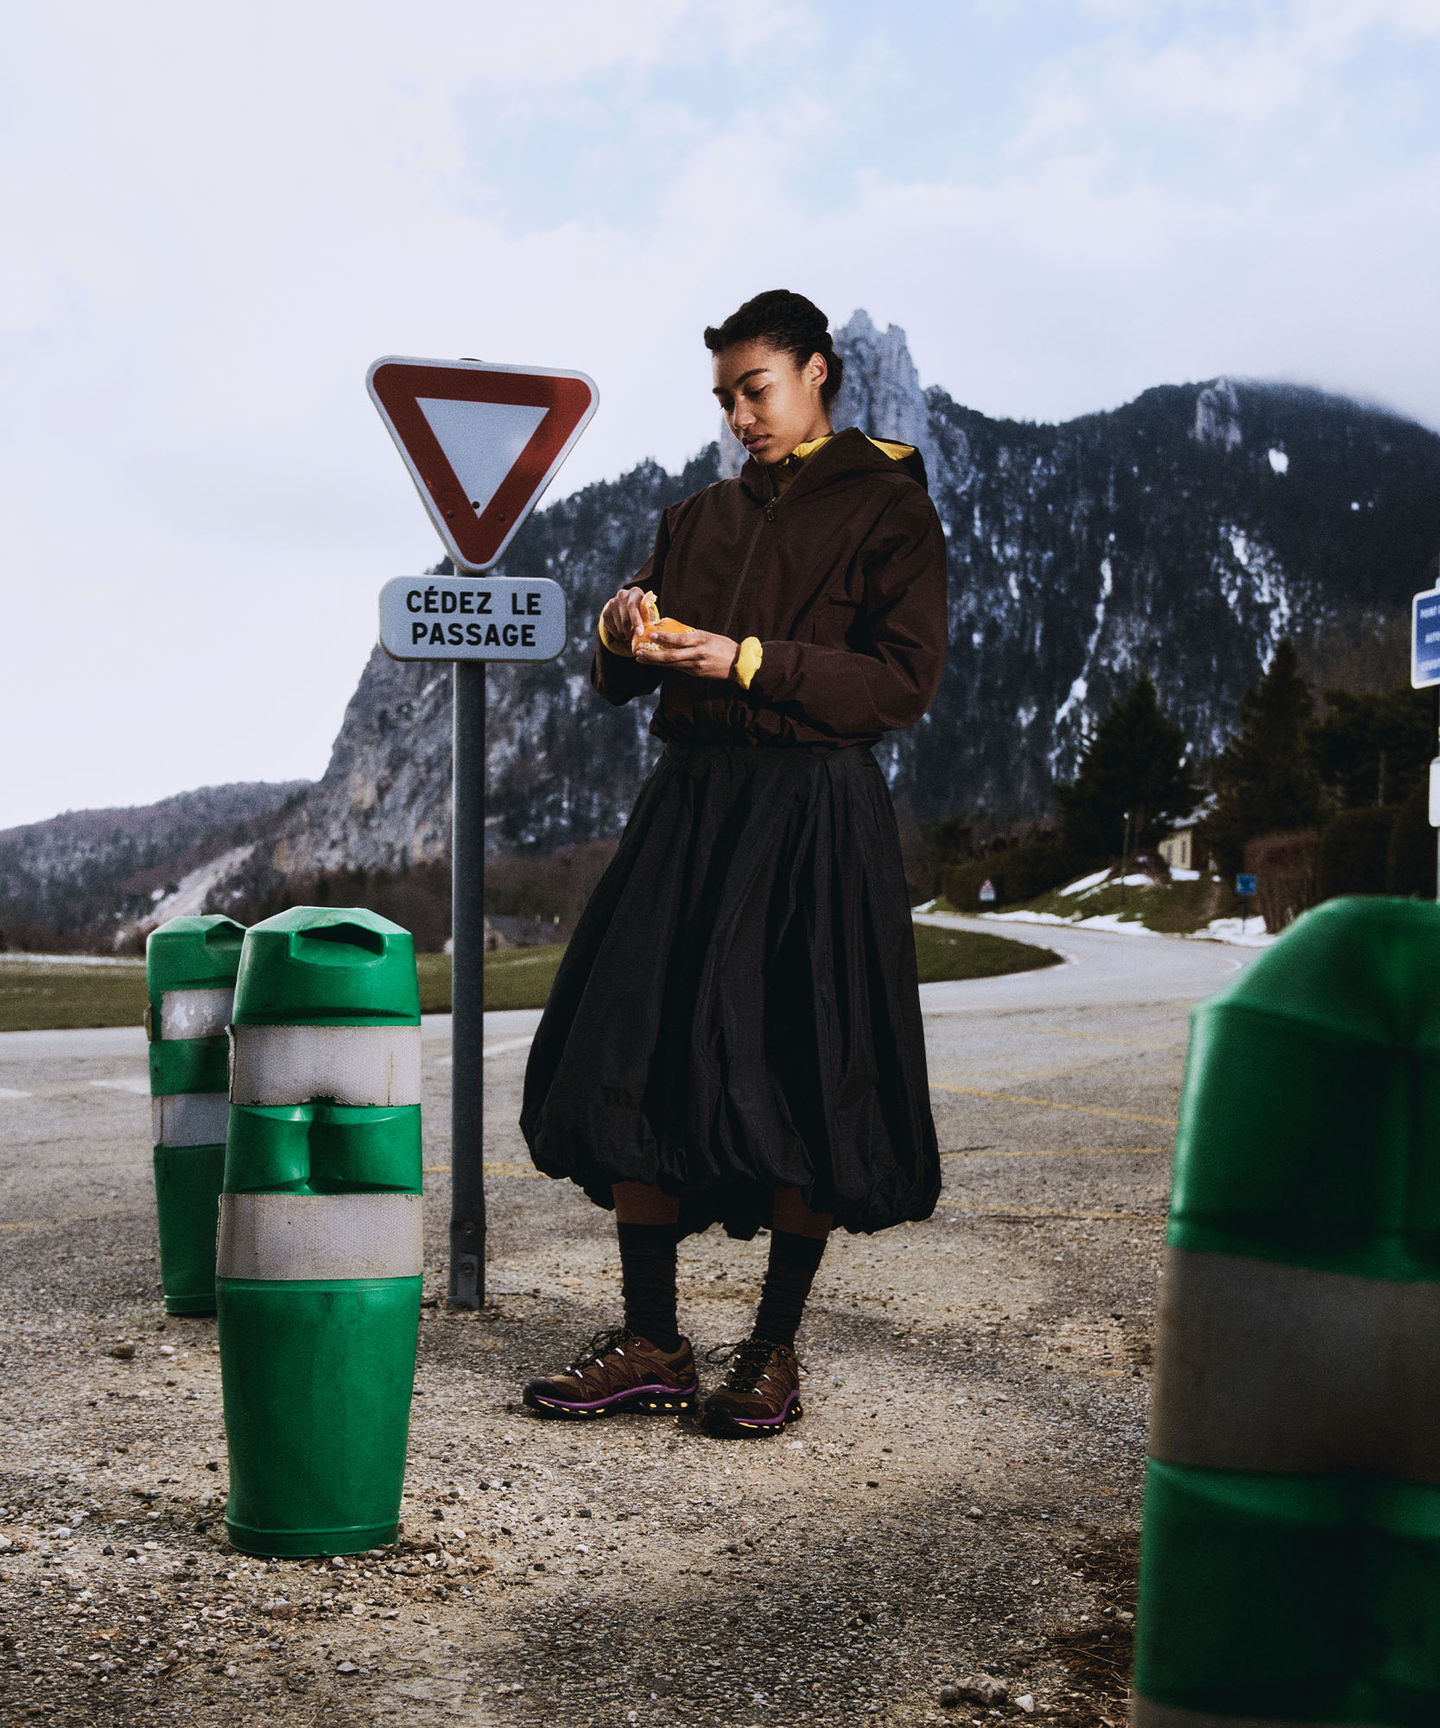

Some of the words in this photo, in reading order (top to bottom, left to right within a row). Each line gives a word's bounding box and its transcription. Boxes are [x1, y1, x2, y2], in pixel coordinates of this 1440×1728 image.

[406, 586, 492, 614] CÉDEZ
[512, 593, 541, 615] LE
[412, 622, 536, 647] PASSAGE
